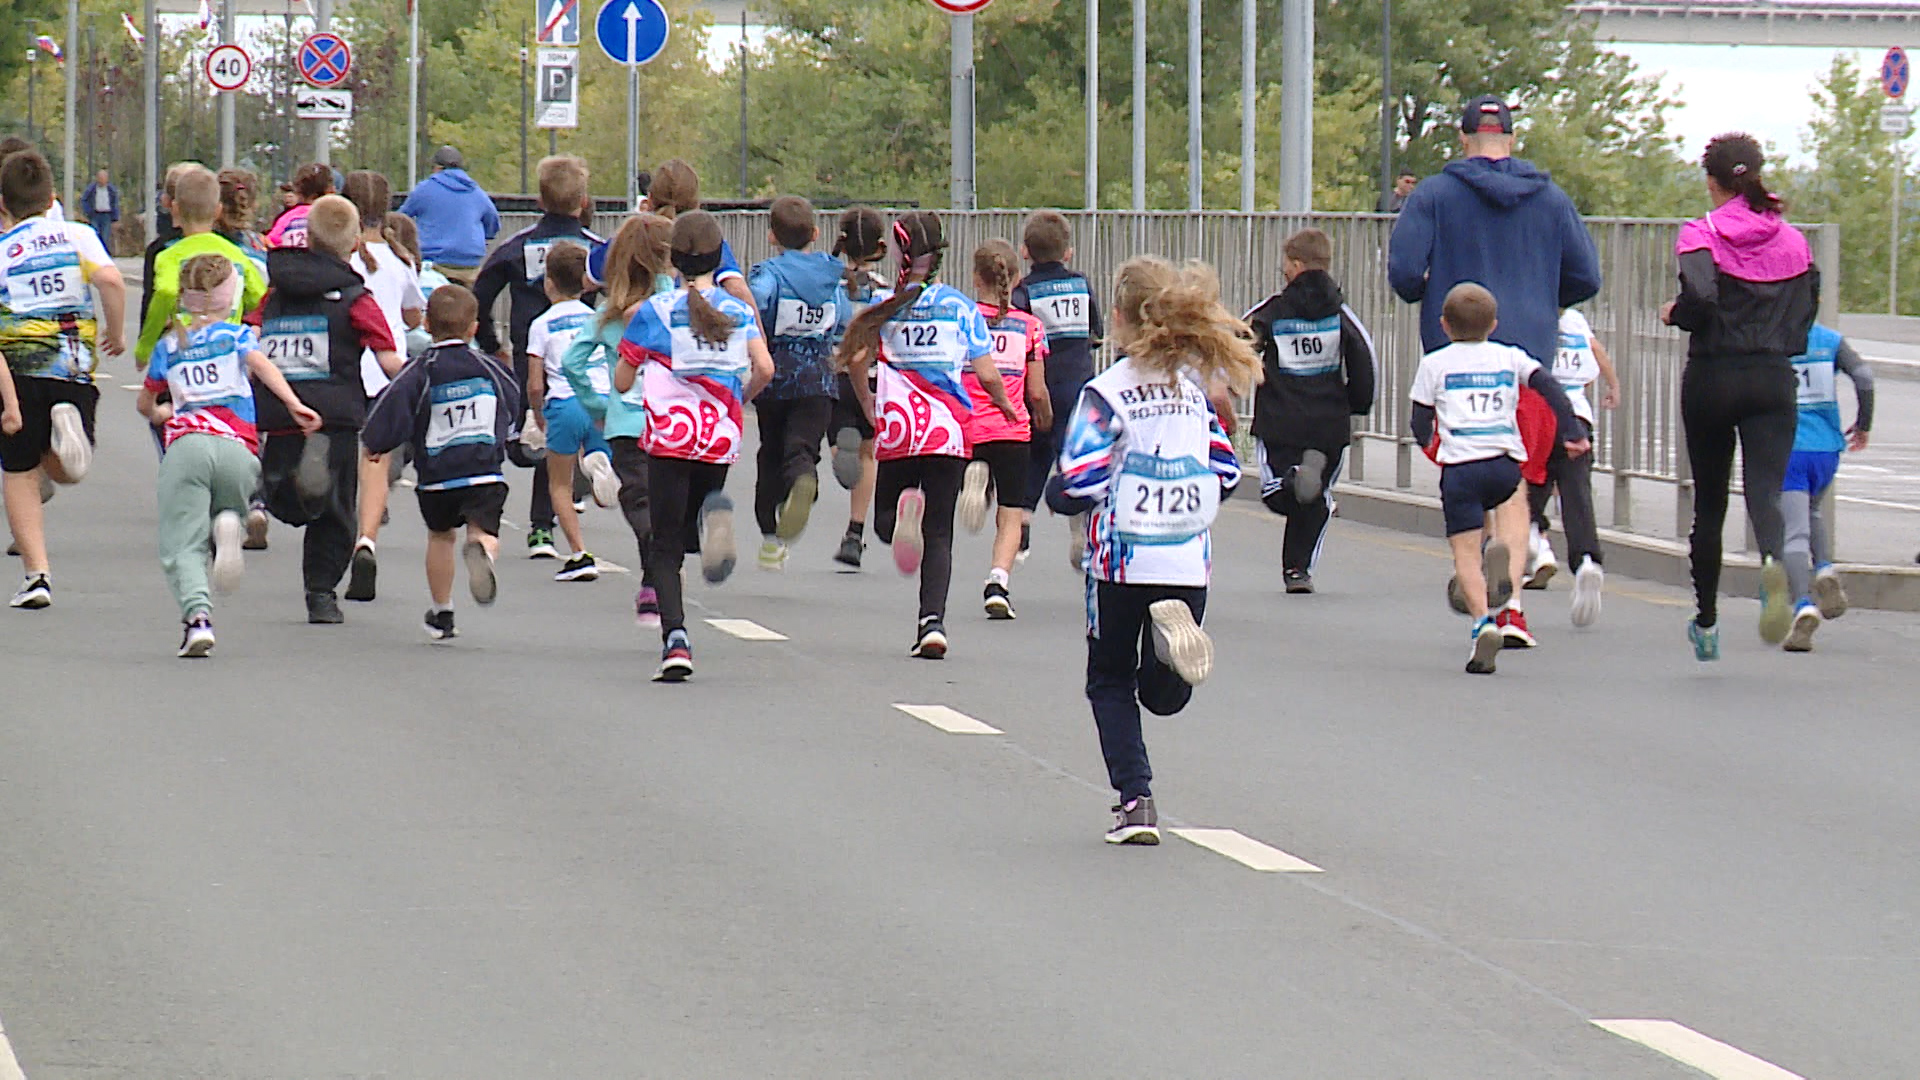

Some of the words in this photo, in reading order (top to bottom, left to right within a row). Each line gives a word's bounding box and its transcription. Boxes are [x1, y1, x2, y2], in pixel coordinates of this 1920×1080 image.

[215, 58, 240, 77] 40
[286, 231, 304, 246] 12
[28, 273, 66, 297] 165
[796, 305, 825, 325] 159
[1051, 298, 1080, 318] 178
[901, 325, 938, 347] 122
[1290, 336, 1322, 356] 160
[267, 337, 313, 360] 2119
[180, 363, 219, 387] 108
[1468, 391, 1503, 413] 175
[443, 401, 477, 429] 171
[1134, 483, 1201, 514] 2128
